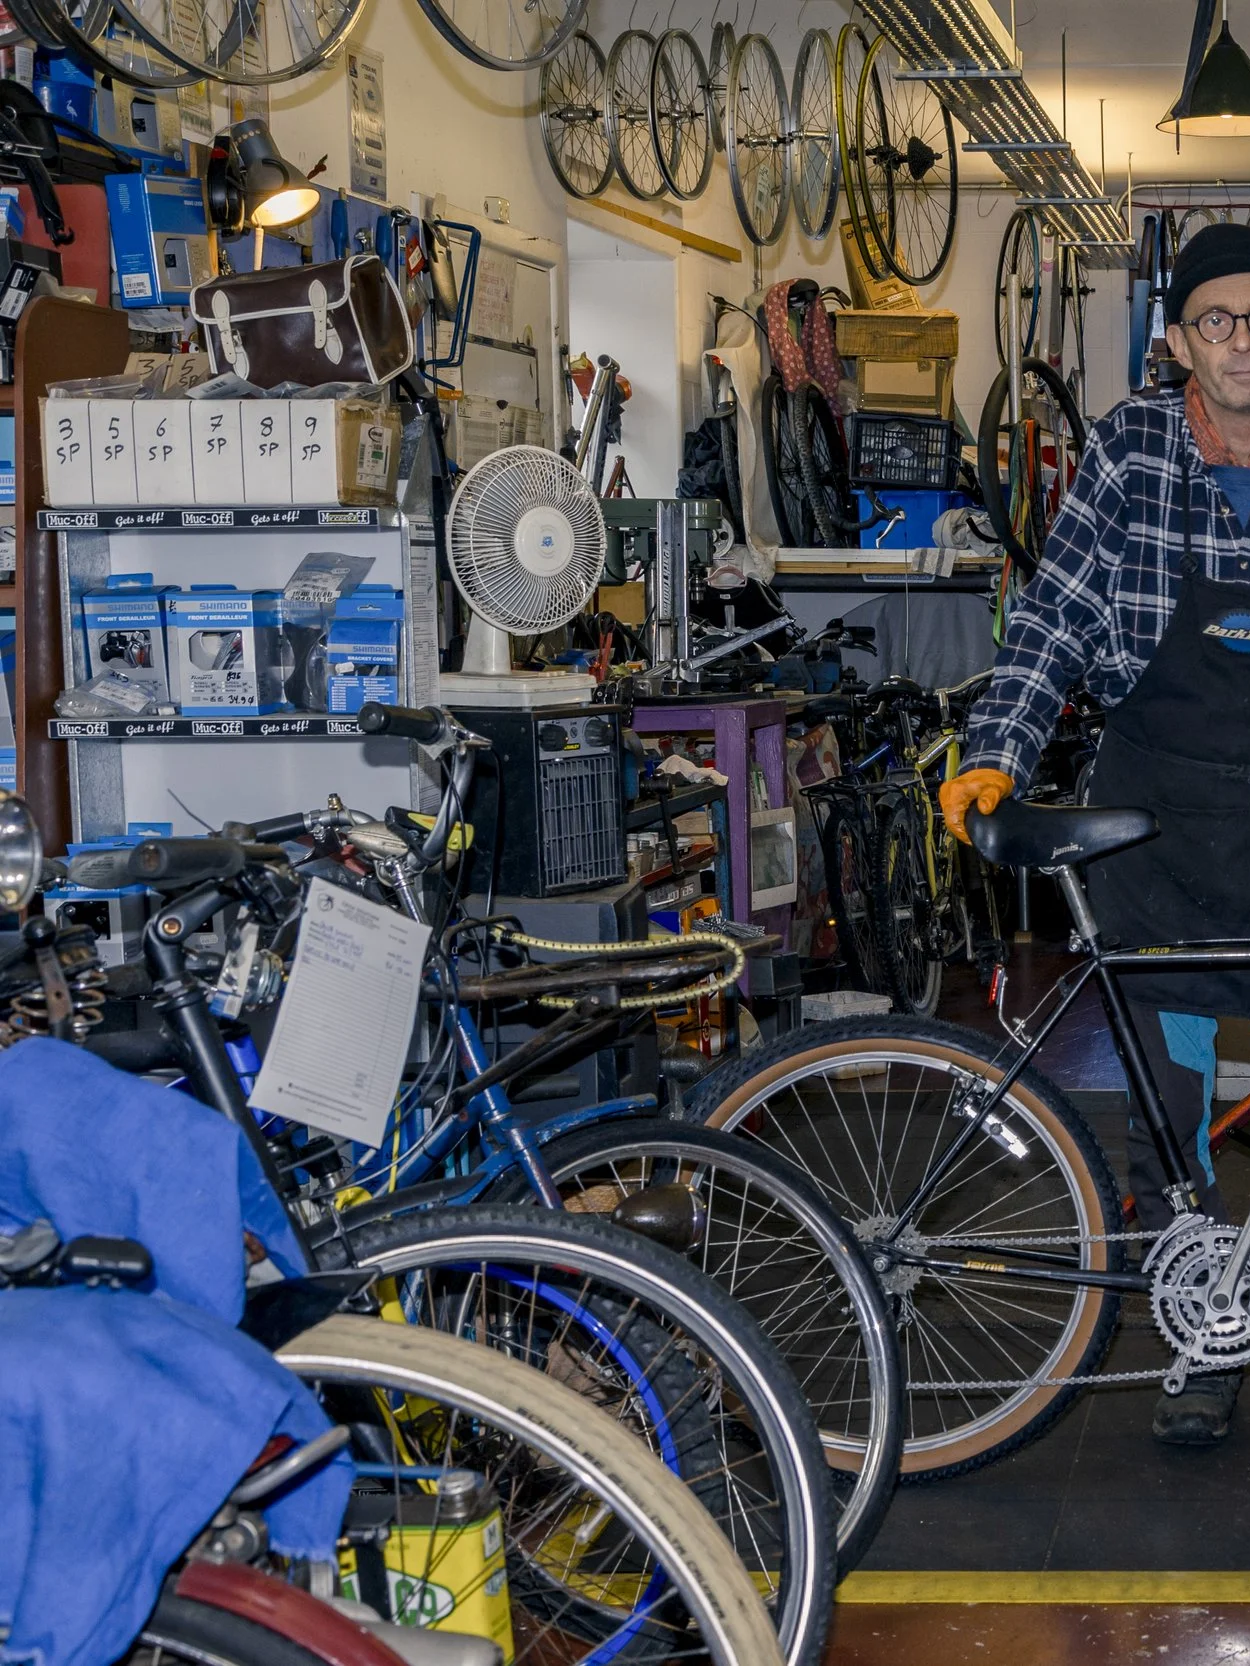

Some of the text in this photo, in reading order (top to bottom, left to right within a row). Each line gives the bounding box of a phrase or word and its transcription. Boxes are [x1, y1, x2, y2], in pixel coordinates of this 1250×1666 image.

[138, 358, 155, 375] 3
[181, 358, 196, 375] 5
[58, 418, 74, 441] 3
[108, 417, 120, 440] 5
[156, 417, 168, 438] 6
[209, 414, 224, 433] 7
[260, 416, 274, 438] 8
[304, 416, 318, 437] 9
[56, 442, 80, 464] SP
[104, 444, 125, 461] SP
[148, 445, 173, 462] SP
[206, 437, 228, 455] SP
[259, 442, 280, 457] SP
[301, 443, 322, 461] SP
[49, 514, 95, 526] Muc-Off
[115, 512, 165, 527] Gets it off!
[185, 512, 231, 525] Muc-Off
[250, 511, 300, 526] Gets it off!
[199, 602, 247, 610] SHIMANO
[352, 645, 393, 653] SHIMANO
[60, 724, 106, 735] Muc-Off
[126, 721, 174, 736] Gets it off!
[195, 721, 241, 733] Muc-Off
[260, 720, 310, 735] Gets it off!
